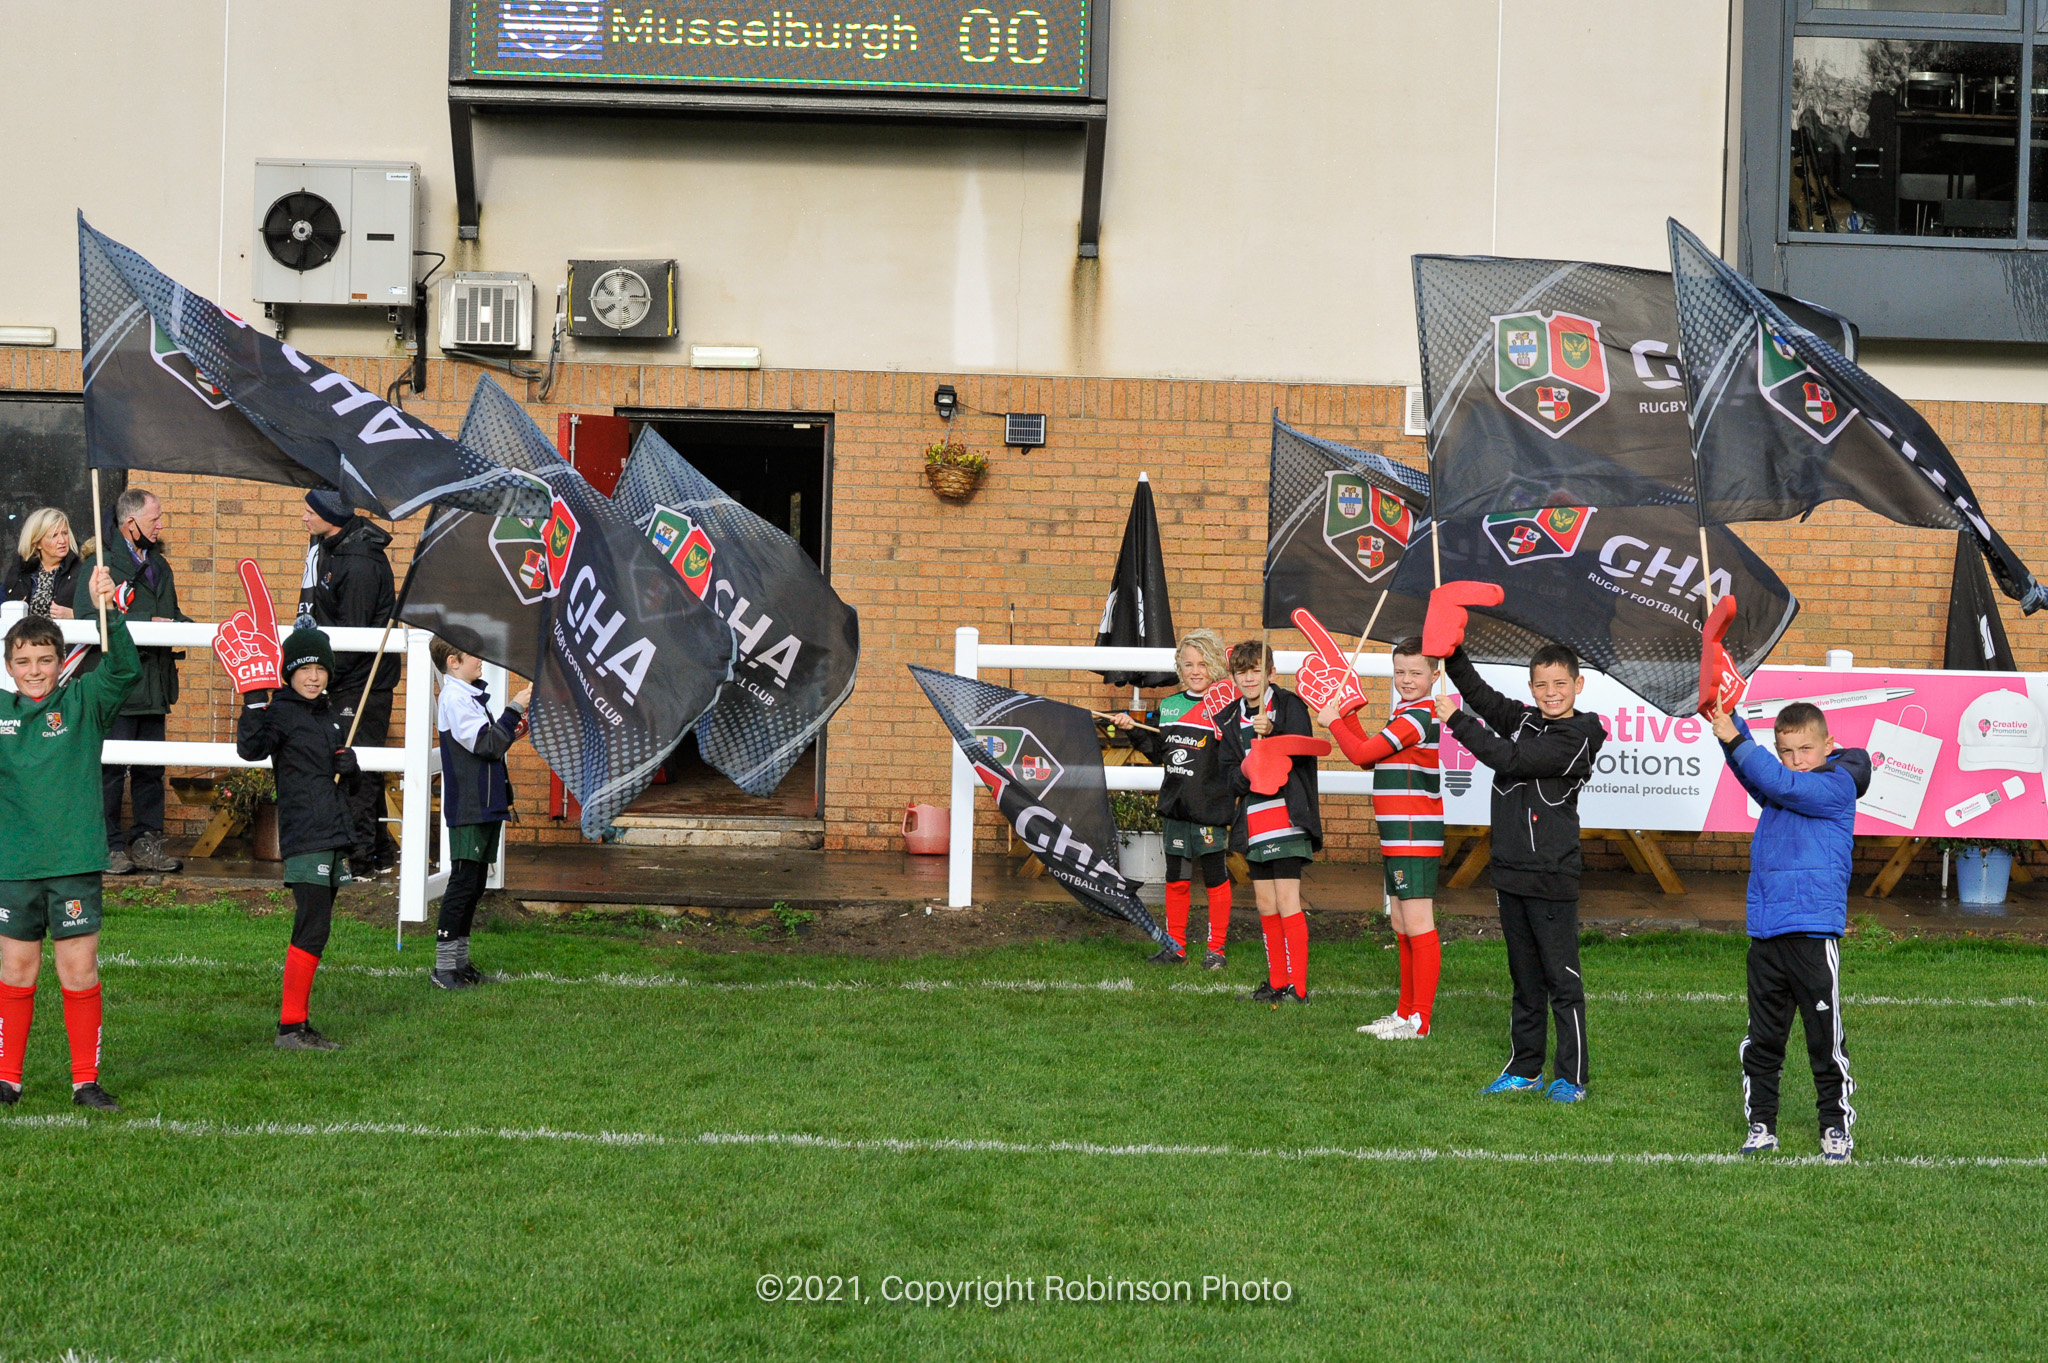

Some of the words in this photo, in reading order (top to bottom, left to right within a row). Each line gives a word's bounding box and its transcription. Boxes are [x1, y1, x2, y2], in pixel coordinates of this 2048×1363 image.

[612, 8, 918, 59] Musselburgh
[958, 8, 1048, 63] 00
[1639, 400, 1687, 413] RUGBY
[1598, 535, 1732, 606] GHA
[1587, 572, 1629, 596] RUGBY
[1630, 592, 1690, 624] FOOTBALL
[1692, 619, 1703, 633] CL
[567, 565, 657, 707] GHA
[297, 656, 319, 664] RUGBY
[238, 661, 276, 679] GHA
[564, 649, 594, 700] FOOTBALL
[594, 696, 623, 726] CLUB
[747, 682, 775, 706] CLUB
[1830, 695, 1868, 705] Promotions
[1992, 720, 2028, 729] Creative
[1166, 764, 1195, 777] Spitfire
[1591, 748, 1701, 777] otions
[1886, 756, 1924, 775] Creative
[1884, 764, 1922, 782] Promotions
[1581, 782, 1640, 795] motional
[1642, 784, 1700, 797] products
[1048, 866, 1101, 892] FOOTBALL
